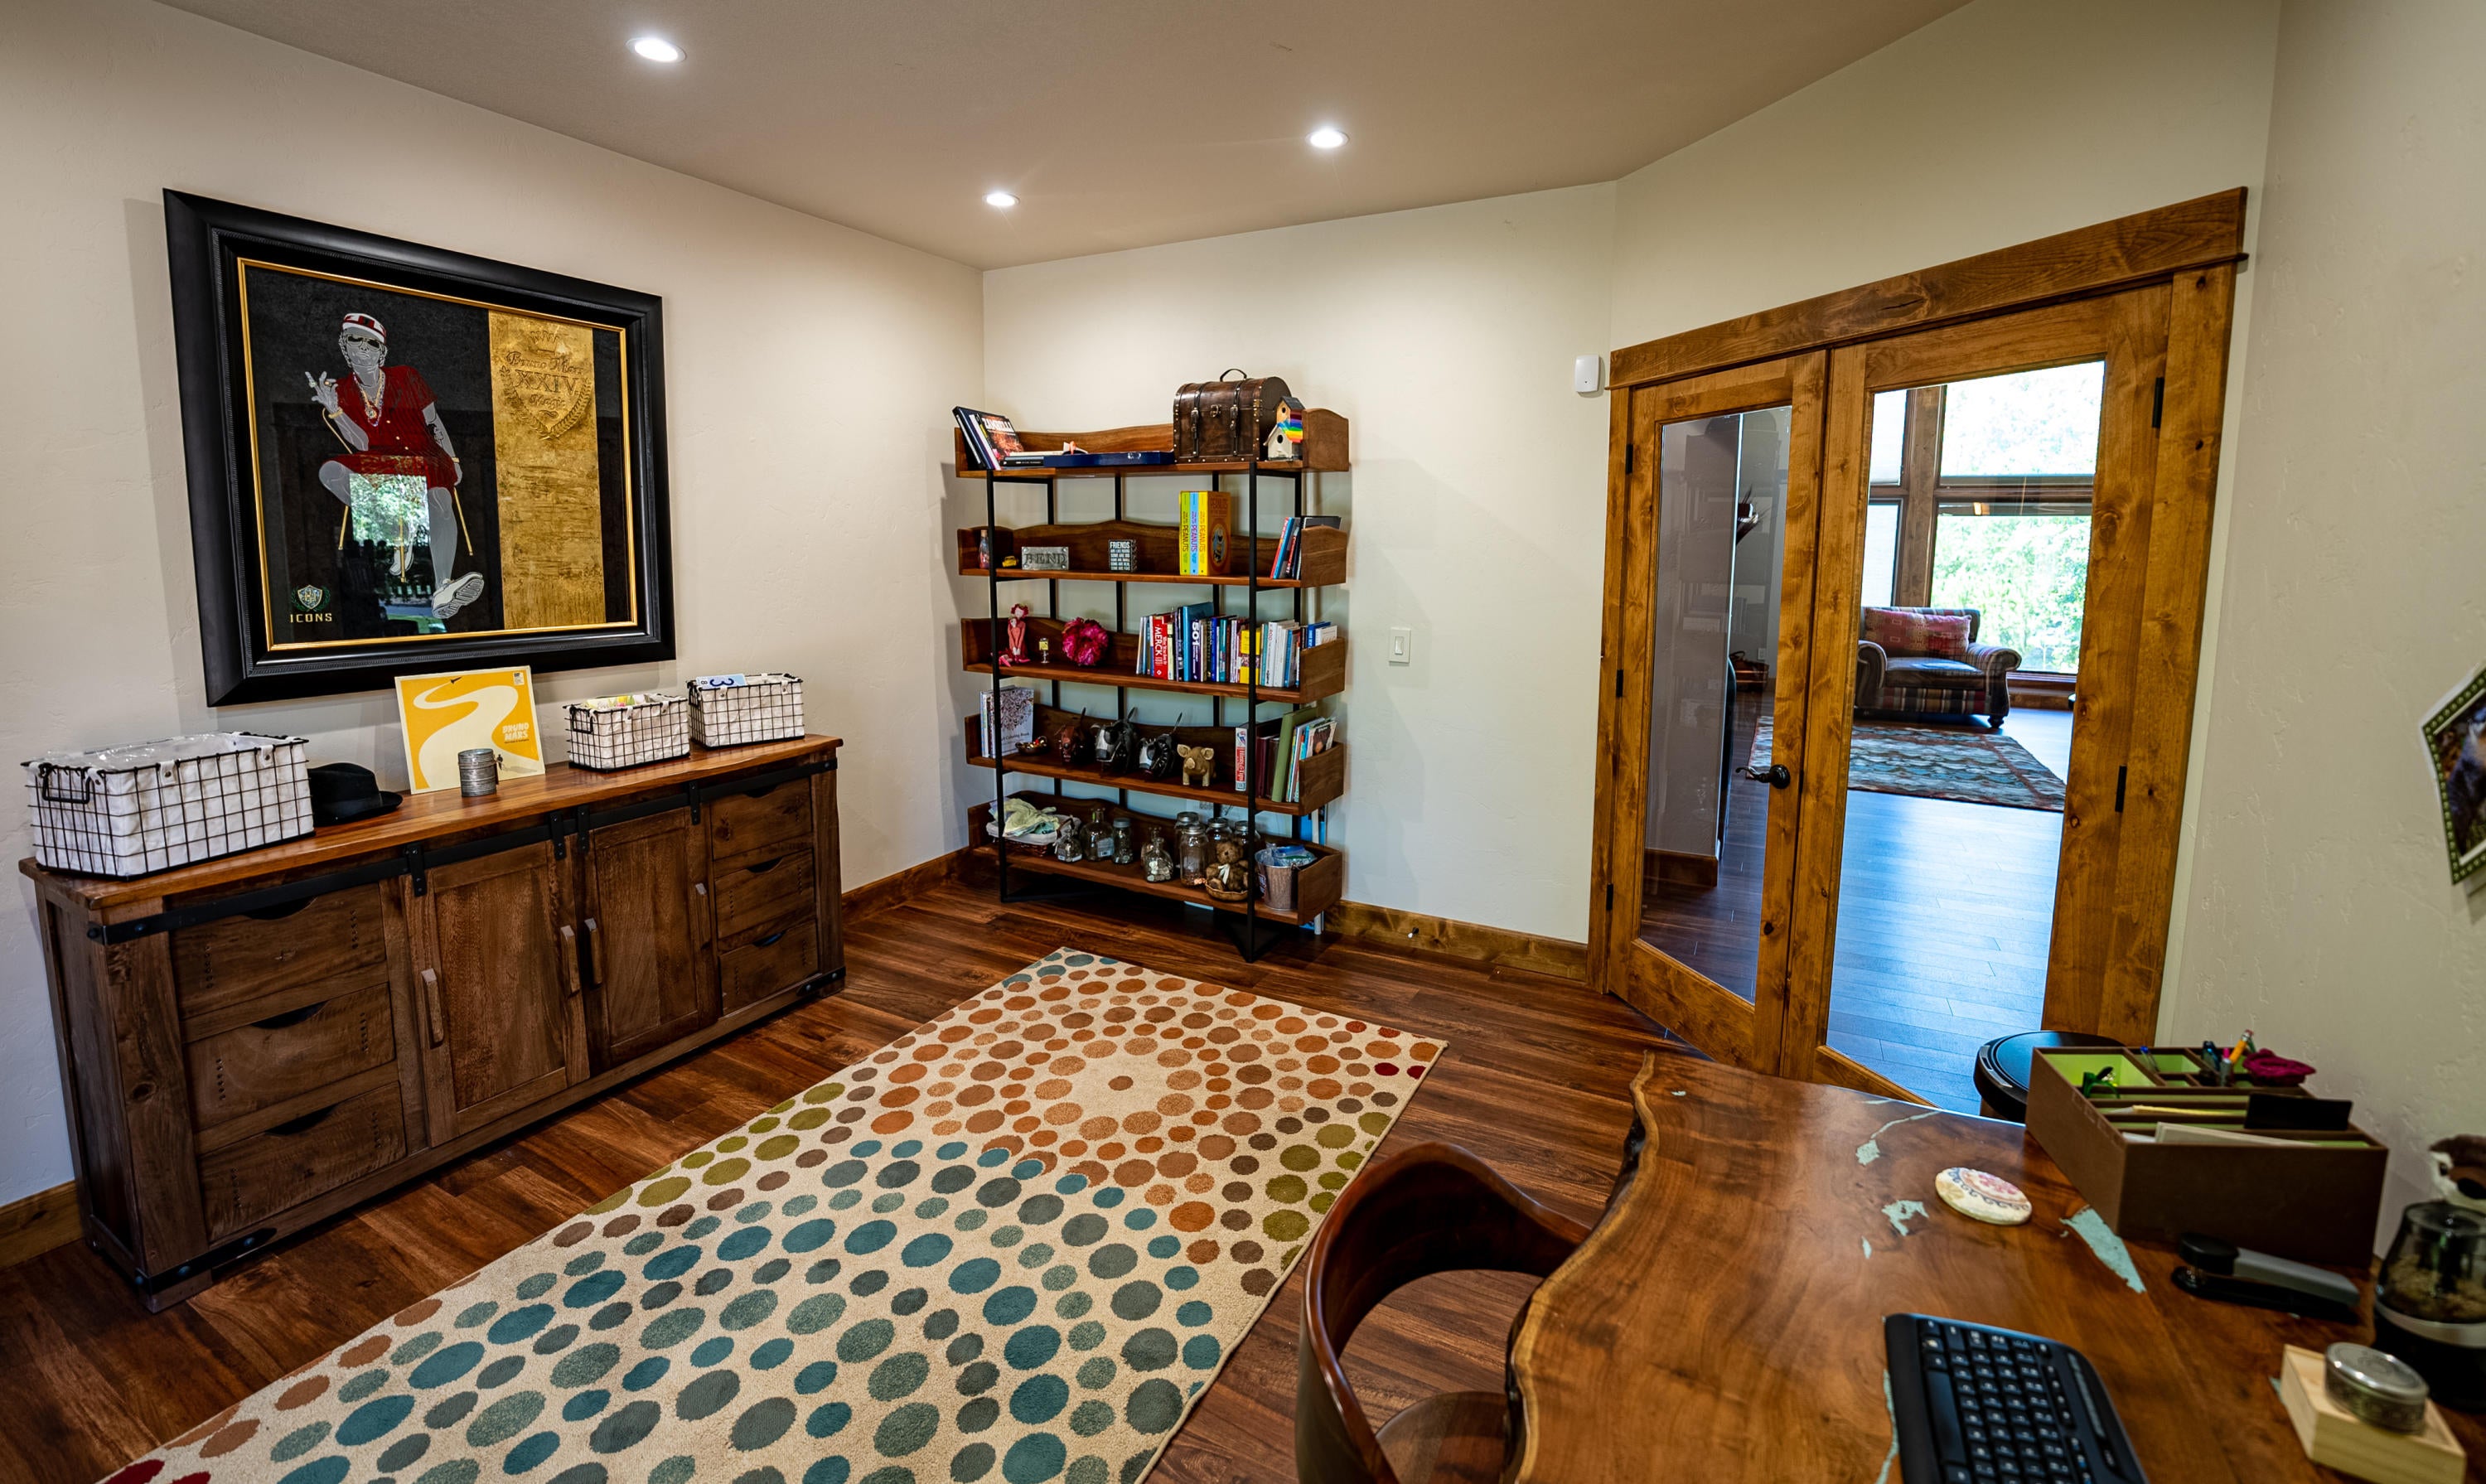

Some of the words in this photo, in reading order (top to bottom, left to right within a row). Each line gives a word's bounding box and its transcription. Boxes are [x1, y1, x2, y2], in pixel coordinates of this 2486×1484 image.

[1024, 553, 1067, 564] BEND
[289, 613, 332, 623] ICONS
[502, 723, 530, 734] BRUNO
[505, 731, 529, 742] MARS
